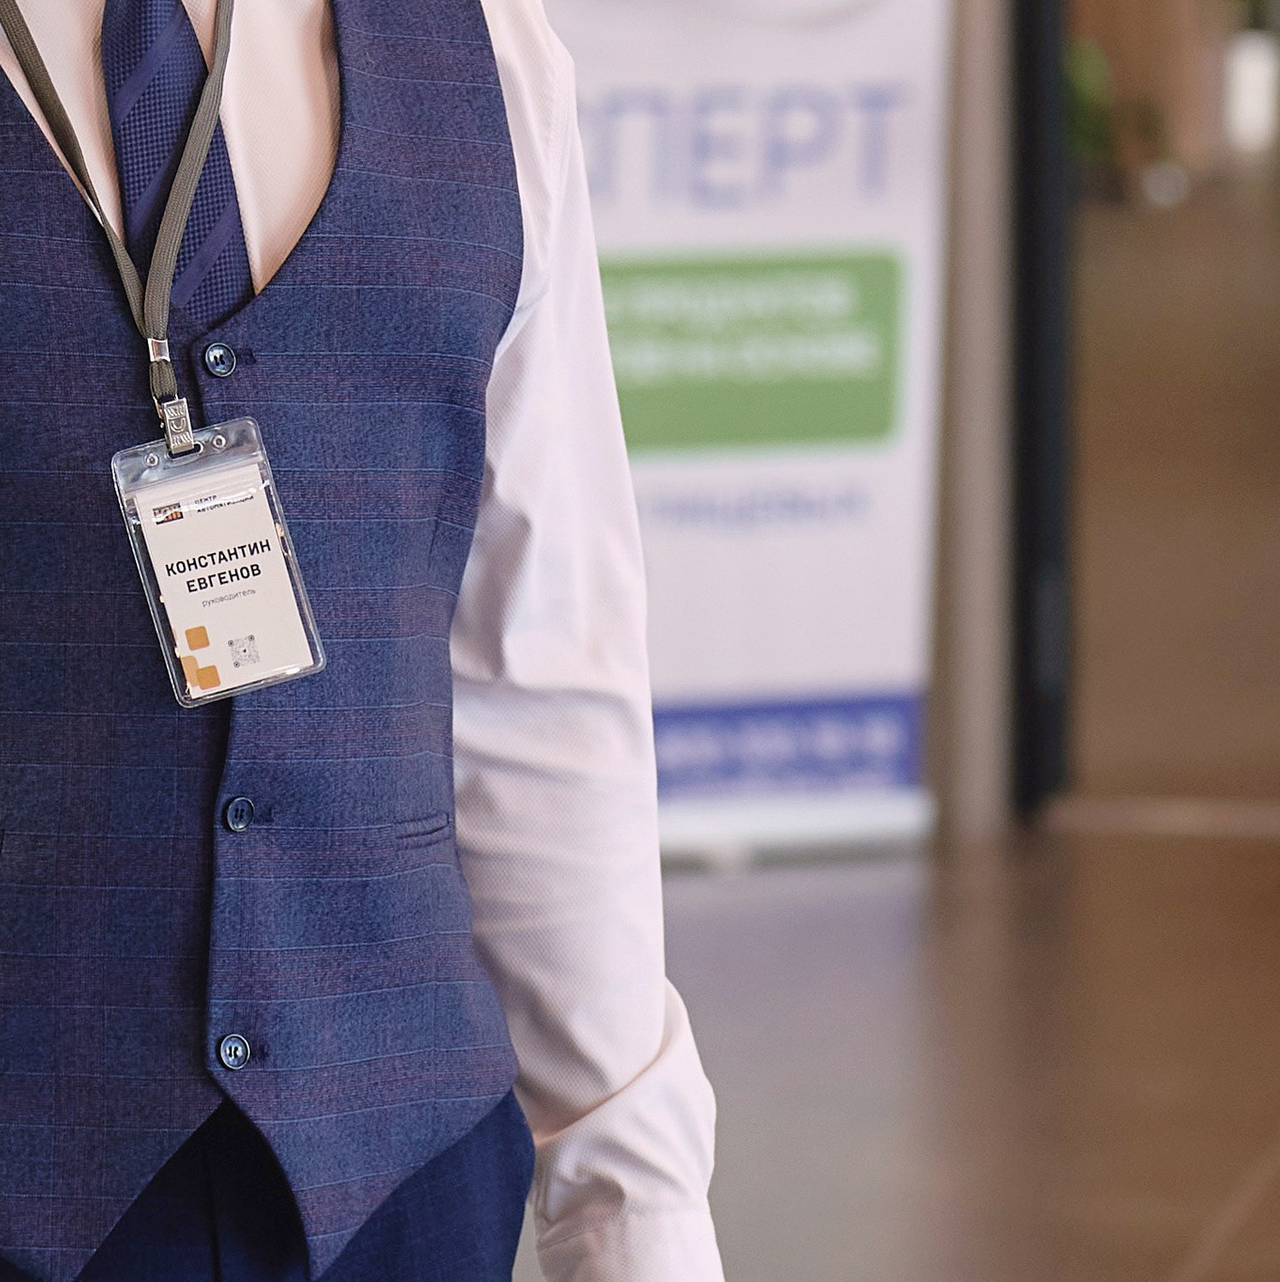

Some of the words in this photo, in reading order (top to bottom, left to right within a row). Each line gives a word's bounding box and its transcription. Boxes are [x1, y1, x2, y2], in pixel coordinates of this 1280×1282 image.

[576, 79, 914, 210] ПЕРТ
[165, 539, 271, 576] КОНСТАНТИН
[186, 563, 261, 593] ЕВГЕНОВ
[201, 588, 256, 608] руководитель
